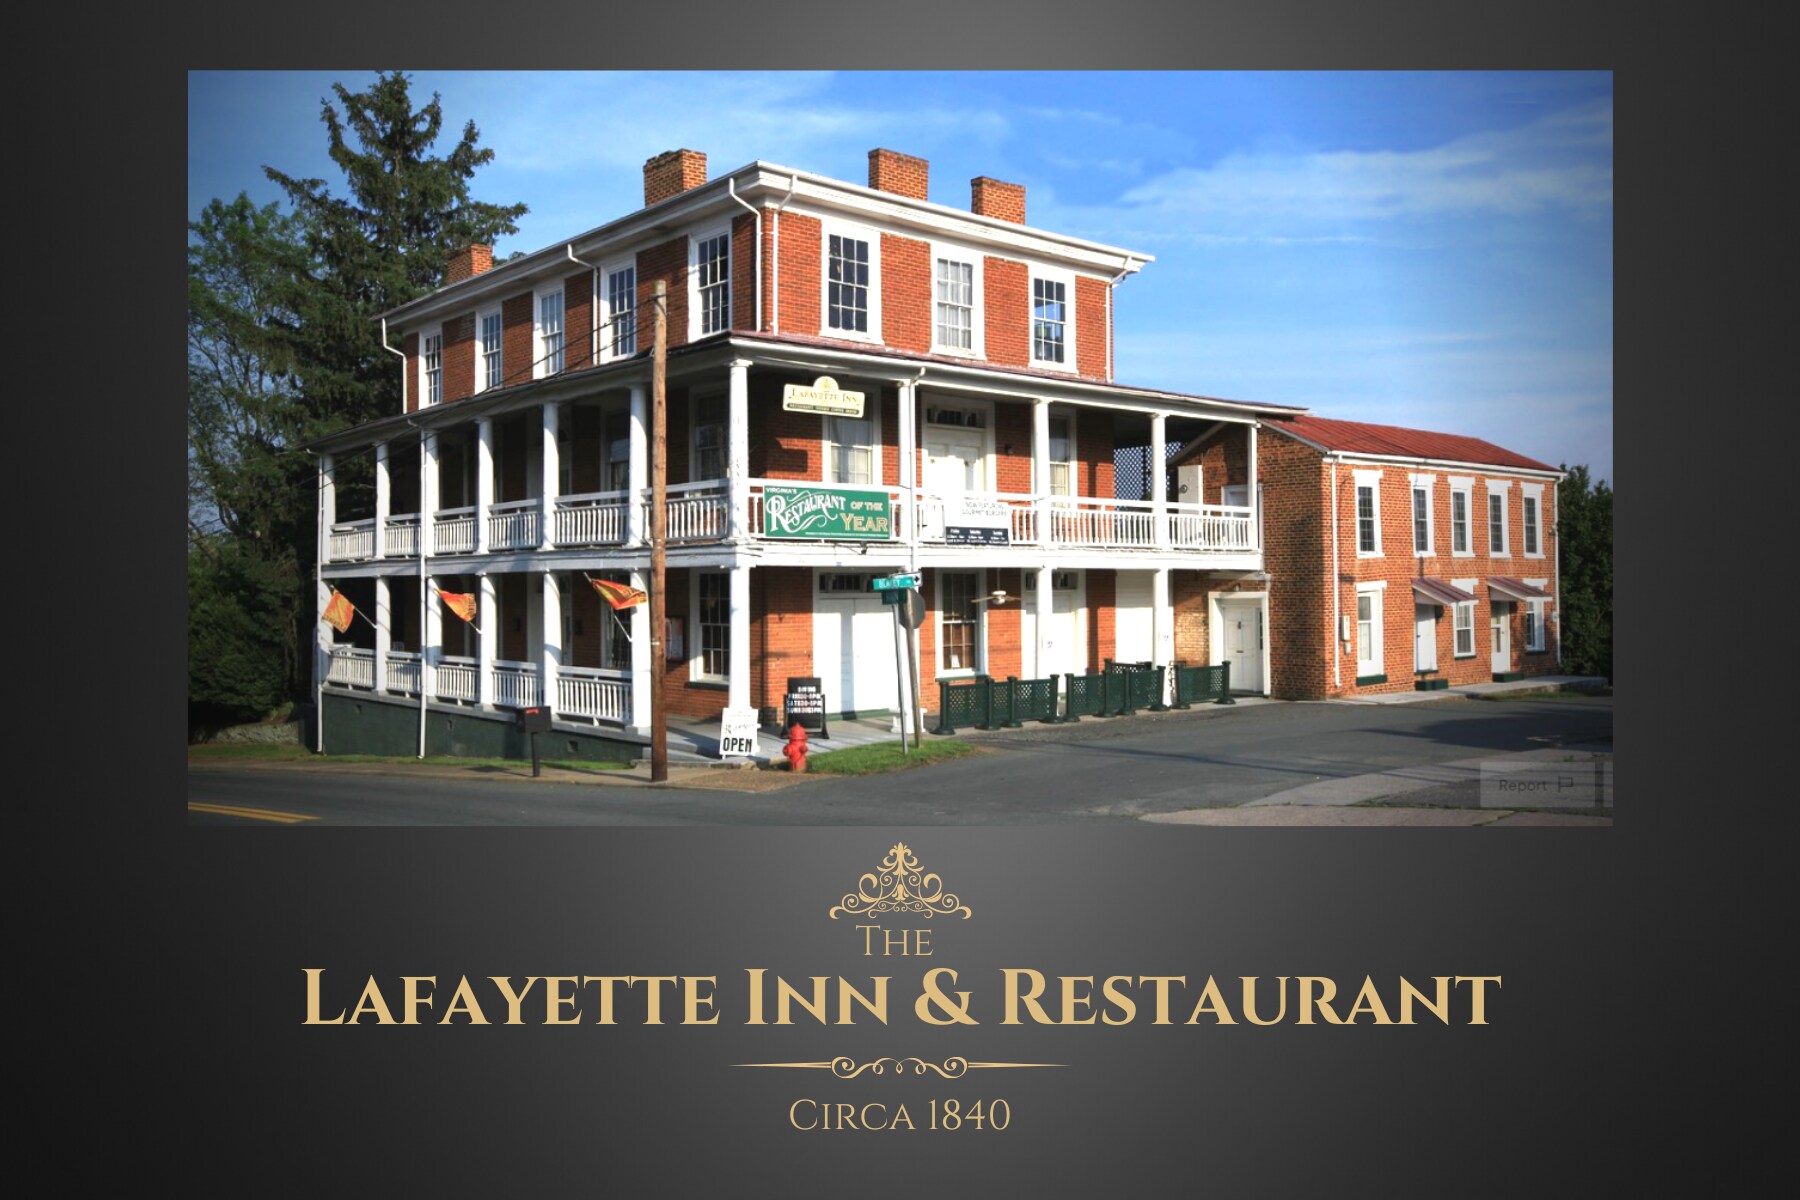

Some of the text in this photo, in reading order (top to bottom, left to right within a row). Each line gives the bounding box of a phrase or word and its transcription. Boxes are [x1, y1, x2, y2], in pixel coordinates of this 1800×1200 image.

[792, 388, 858, 403] LAFAYETTE INN
[766, 494, 883, 532] RESTAURANT OF THE
[840, 513, 888, 532] YEAR
[723, 737, 753, 753] OPEN
